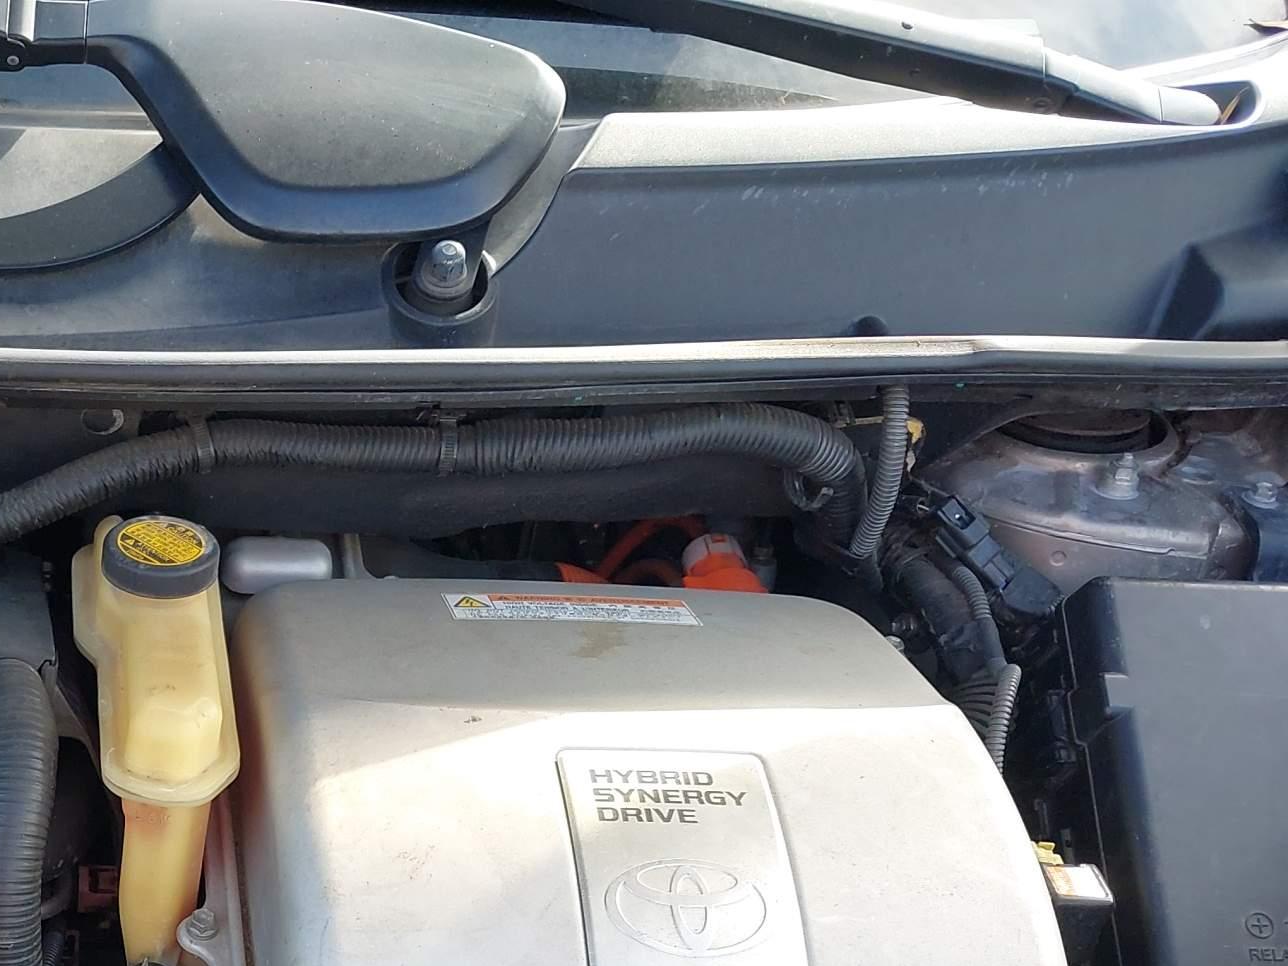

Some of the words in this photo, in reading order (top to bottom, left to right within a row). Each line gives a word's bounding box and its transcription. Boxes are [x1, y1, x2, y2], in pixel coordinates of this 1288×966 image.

[589, 769, 714, 787] HYBRID
[594, 788, 748, 807] SYNERGY
[597, 807, 699, 824] DRIVE
